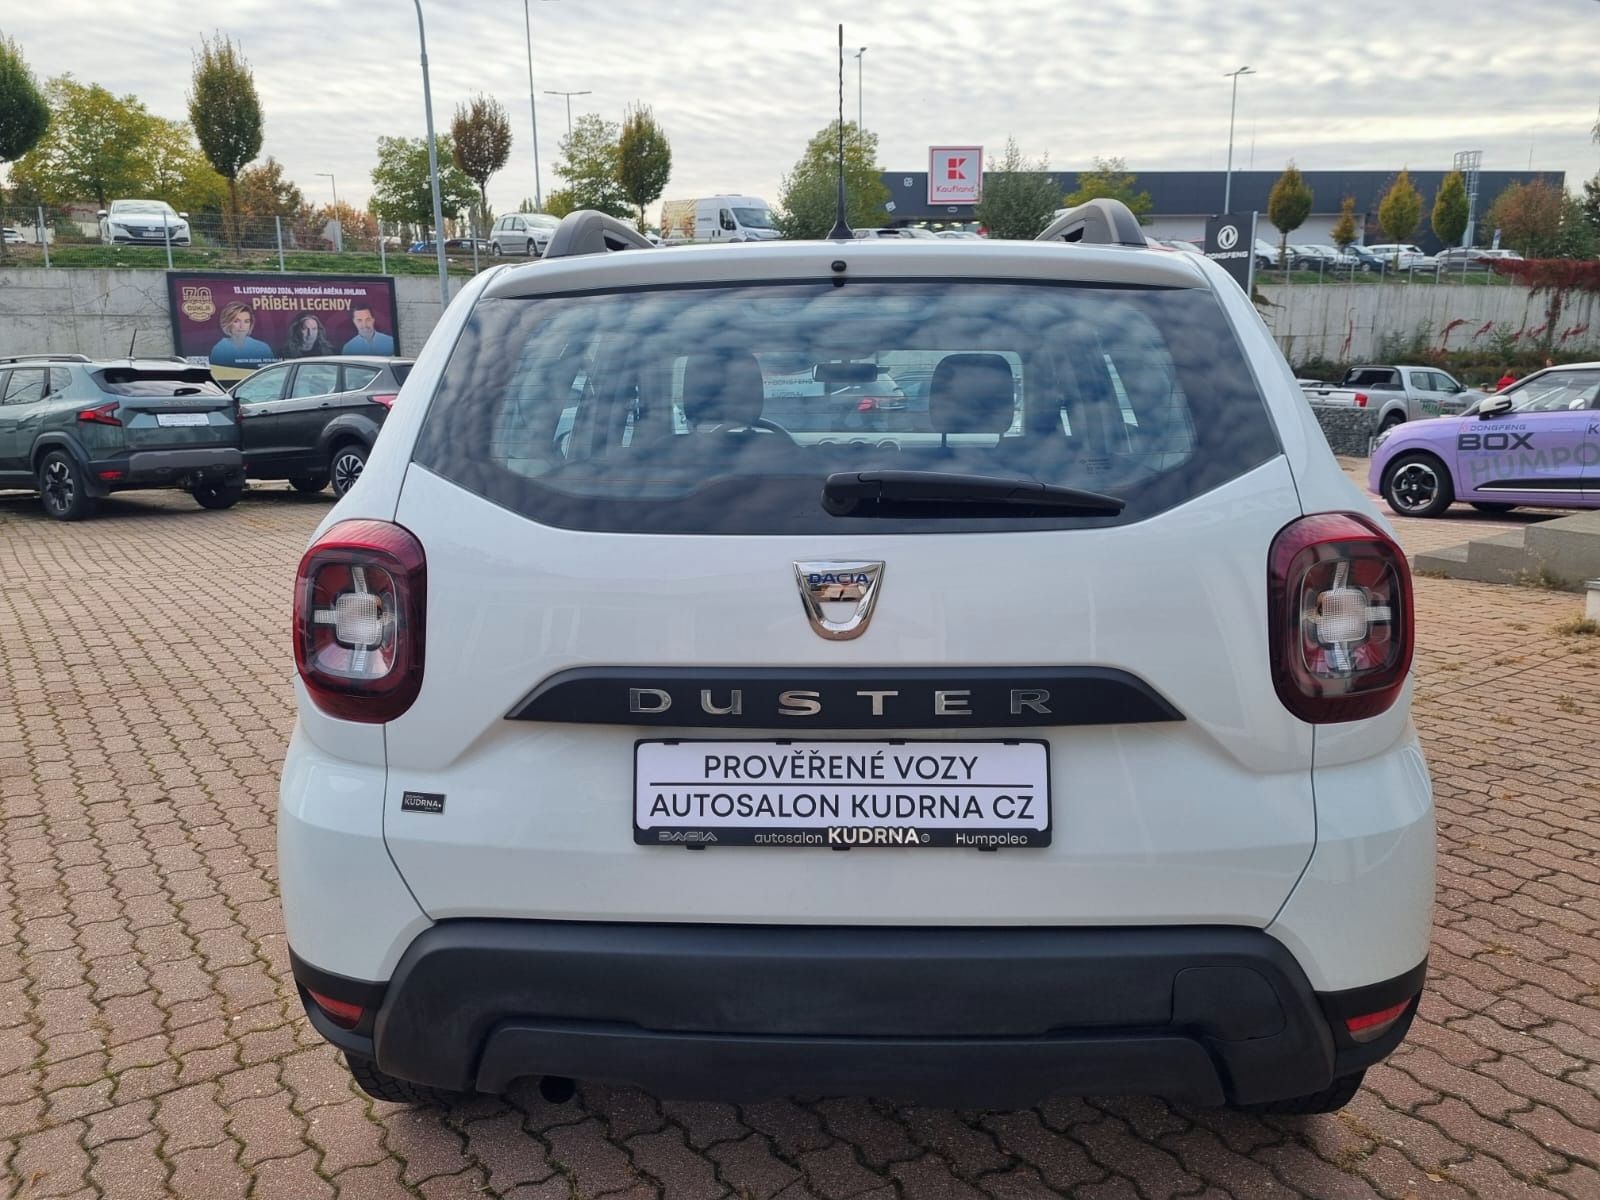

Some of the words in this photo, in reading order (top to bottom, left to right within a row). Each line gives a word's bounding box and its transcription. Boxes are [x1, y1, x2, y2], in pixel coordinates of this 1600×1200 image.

[936, 185, 975, 193] Kaufland
[243, 286, 277, 294] LISTOPADU
[252, 295, 298, 310] PŘÍBĚH
[300, 298, 351, 311] LEGENDY
[1458, 432, 1535, 450] BOX
[808, 573, 868, 584] DACIA
[629, 687, 1052, 716] DUSTER
[704, 750, 885, 779] PROVĚŘENÉ
[893, 756, 978, 780] VOZY
[649, 793, 840, 818] AUTOSALON
[851, 794, 984, 819] KUDRNA
[992, 795, 1035, 820] CZ
[658, 831, 718, 842] DACIA
[754, 832, 823, 844] autosalon
[828, 828, 920, 844] KUDRNA
[956, 833, 1028, 846] Humpolec
